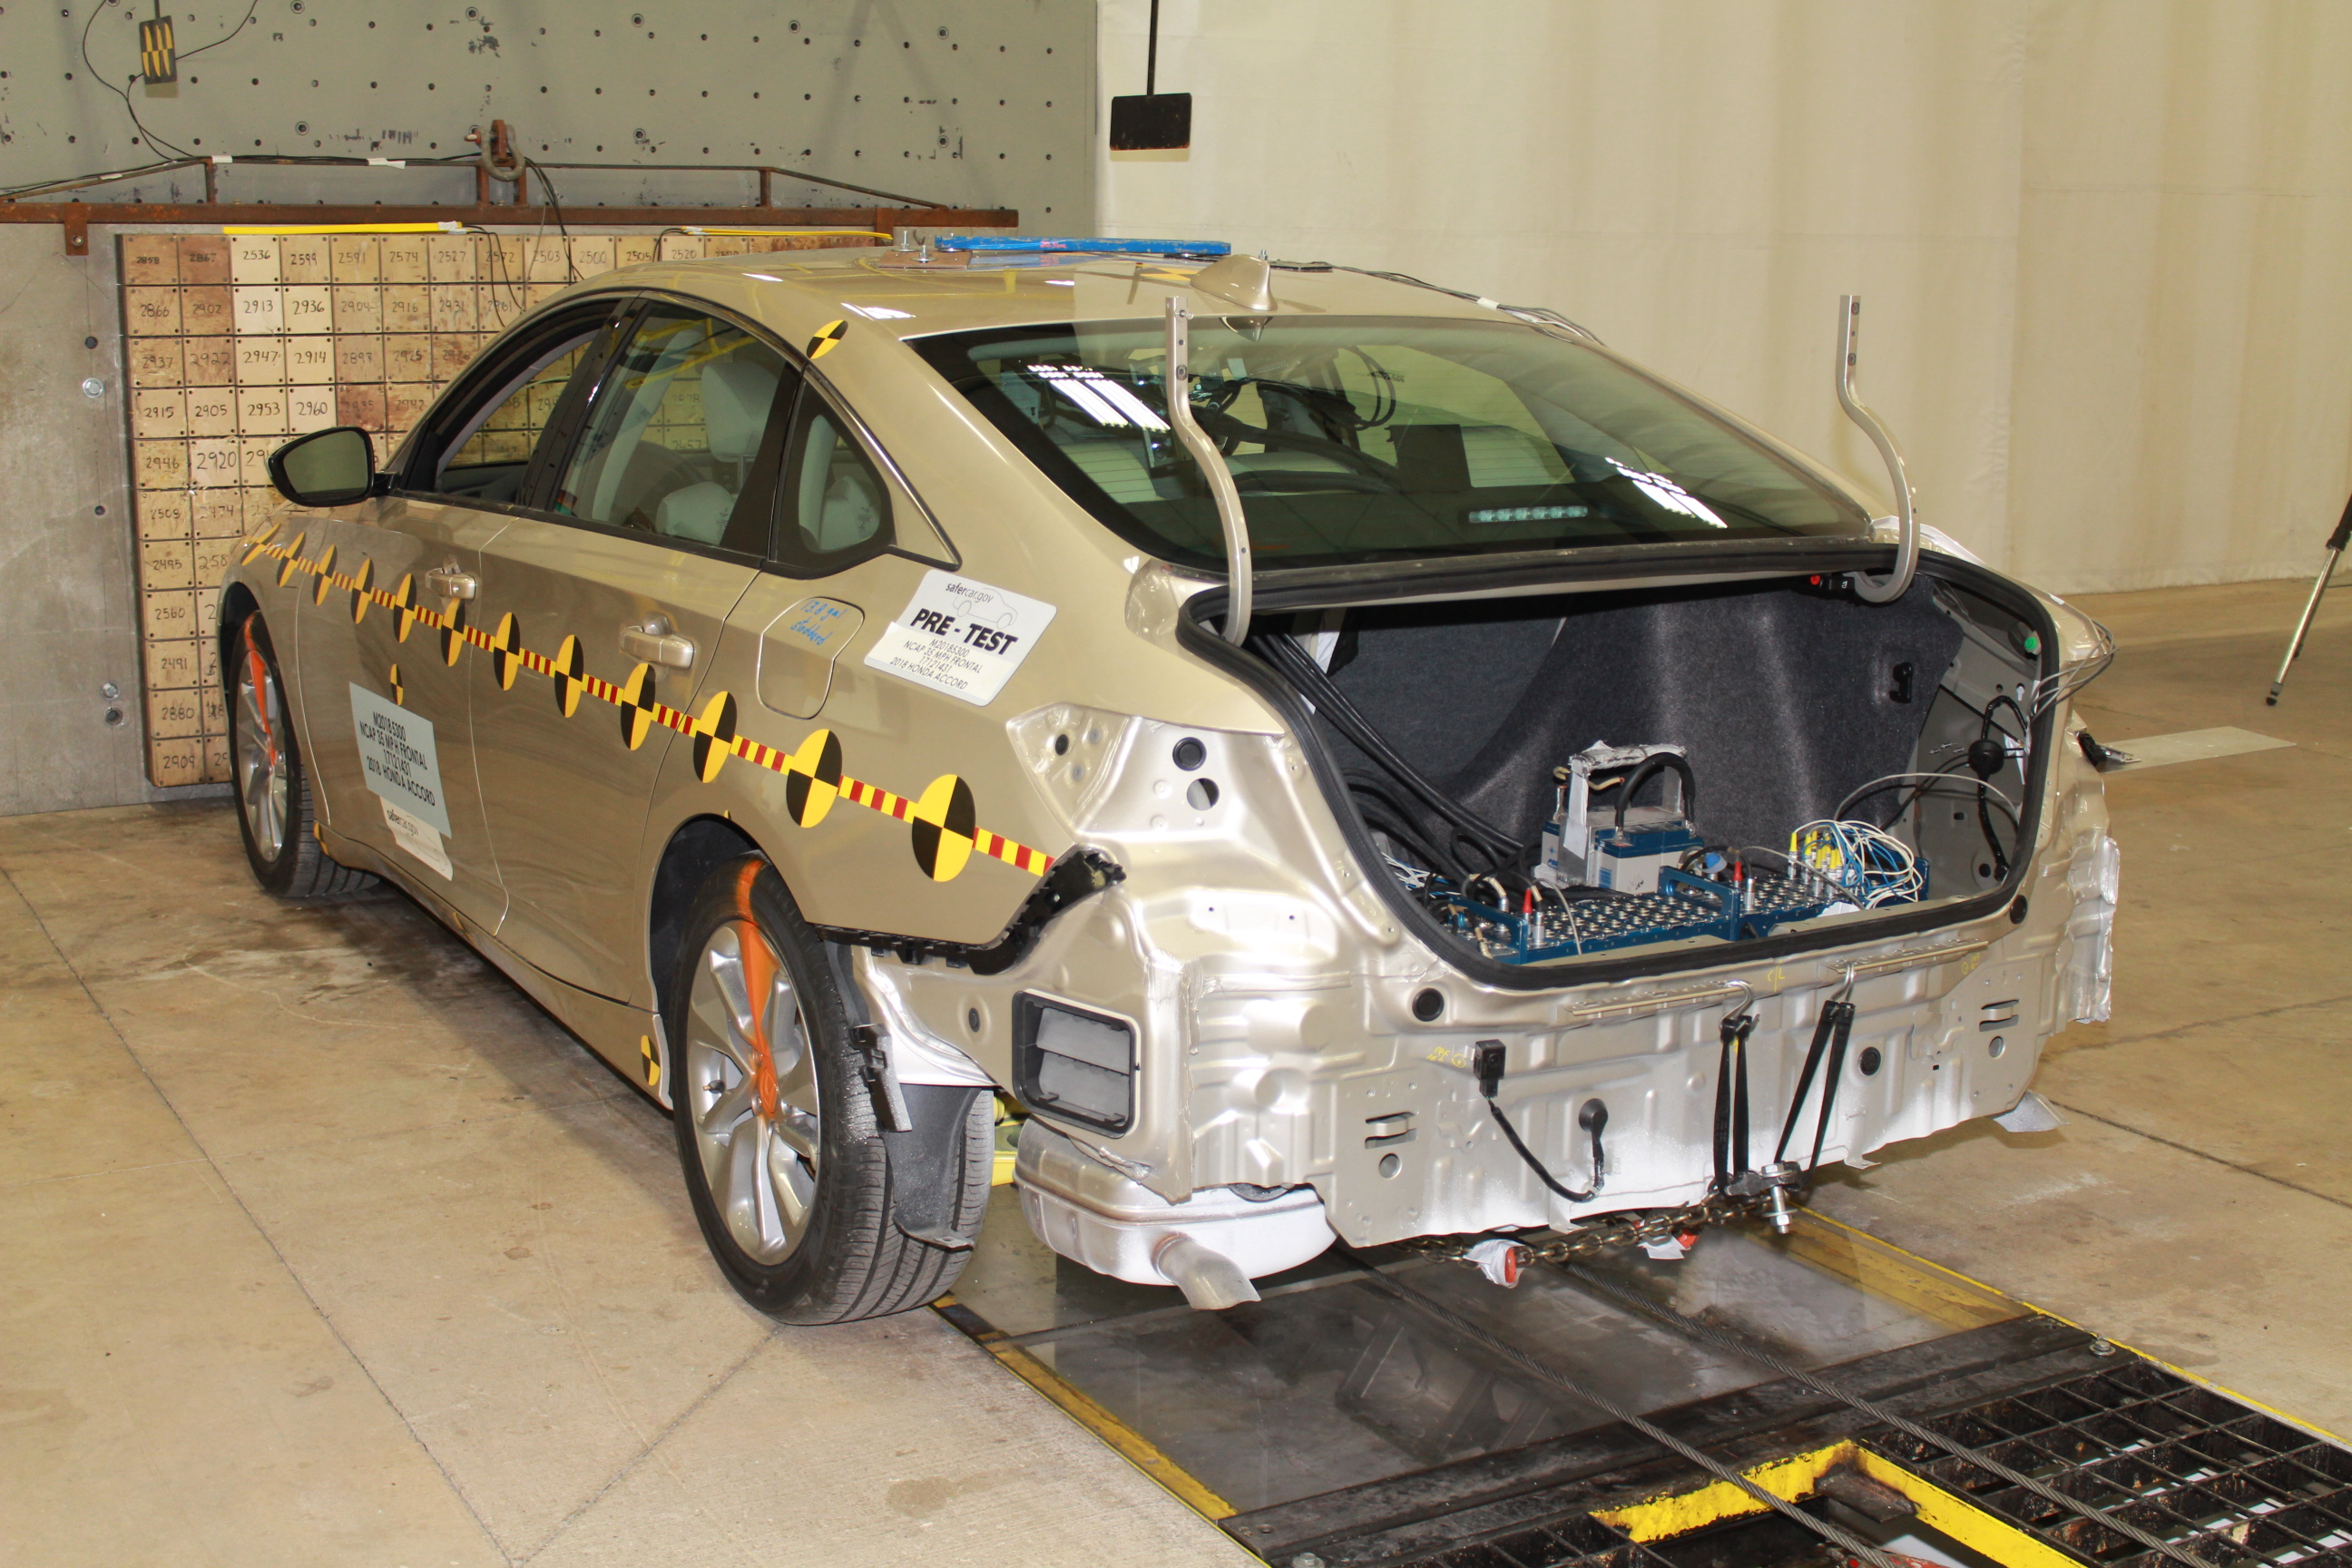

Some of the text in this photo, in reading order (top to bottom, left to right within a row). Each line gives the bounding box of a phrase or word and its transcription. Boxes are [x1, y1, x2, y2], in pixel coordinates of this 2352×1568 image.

[137, 256, 160, 264] 2858
[190, 253, 216, 262] 2867
[243, 250, 270, 260] 2536
[290, 252, 318, 266] 2599
[338, 252, 366, 264] 2591
[389, 251, 418, 263] 2574
[438, 251, 466, 263] 2527
[534, 250, 561, 263] 2503
[580, 251, 607, 264] 2500
[626, 250, 652, 262] 2505
[671, 250, 697, 260] 2520
[141, 303, 170, 317] 2866
[192, 304, 221, 314] 2902
[244, 300, 274, 314] 2913
[293, 300, 325, 315] 2936
[392, 301, 418, 313] 2916
[439, 300, 465, 312] 2931
[142, 356, 173, 368] 2937
[191, 352, 230, 367] 2922
[242, 350, 279, 363] 2947
[294, 351, 327, 364] 2914
[195, 405, 228, 417] 2905
[247, 402, 280, 416] 2953
[296, 402, 328, 416] 2960
[397, 399, 425, 411] 2942
[143, 406, 174, 418] 2915
[146, 457, 180, 469] 2946
[197, 451, 237, 470] 2920
[152, 559, 182, 571] 2495
[946, 583, 994, 603] safercar.gov
[155, 608, 186, 620] 2560
[910, 608, 956, 636] PRE
[964, 623, 1019, 655] TEST
[930, 639, 970, 657] M20185300
[904, 641, 983, 673] NCAP 35 MPH FRONTAL
[162, 658, 188, 670] 2491
[919, 656, 952, 672] 17121431
[890, 657, 968, 690] 2018 HONDA ACCORD
[162, 708, 194, 720] 2880
[373, 710, 406, 741] M20185300
[359, 720, 376, 741] NCAP
[377, 730, 385, 746] 35
[399, 742, 427, 770] FRONTAL
[163, 756, 195, 769] 2909
[383, 764, 407, 790] HONDA
[407, 779, 436, 806] ACCORD
